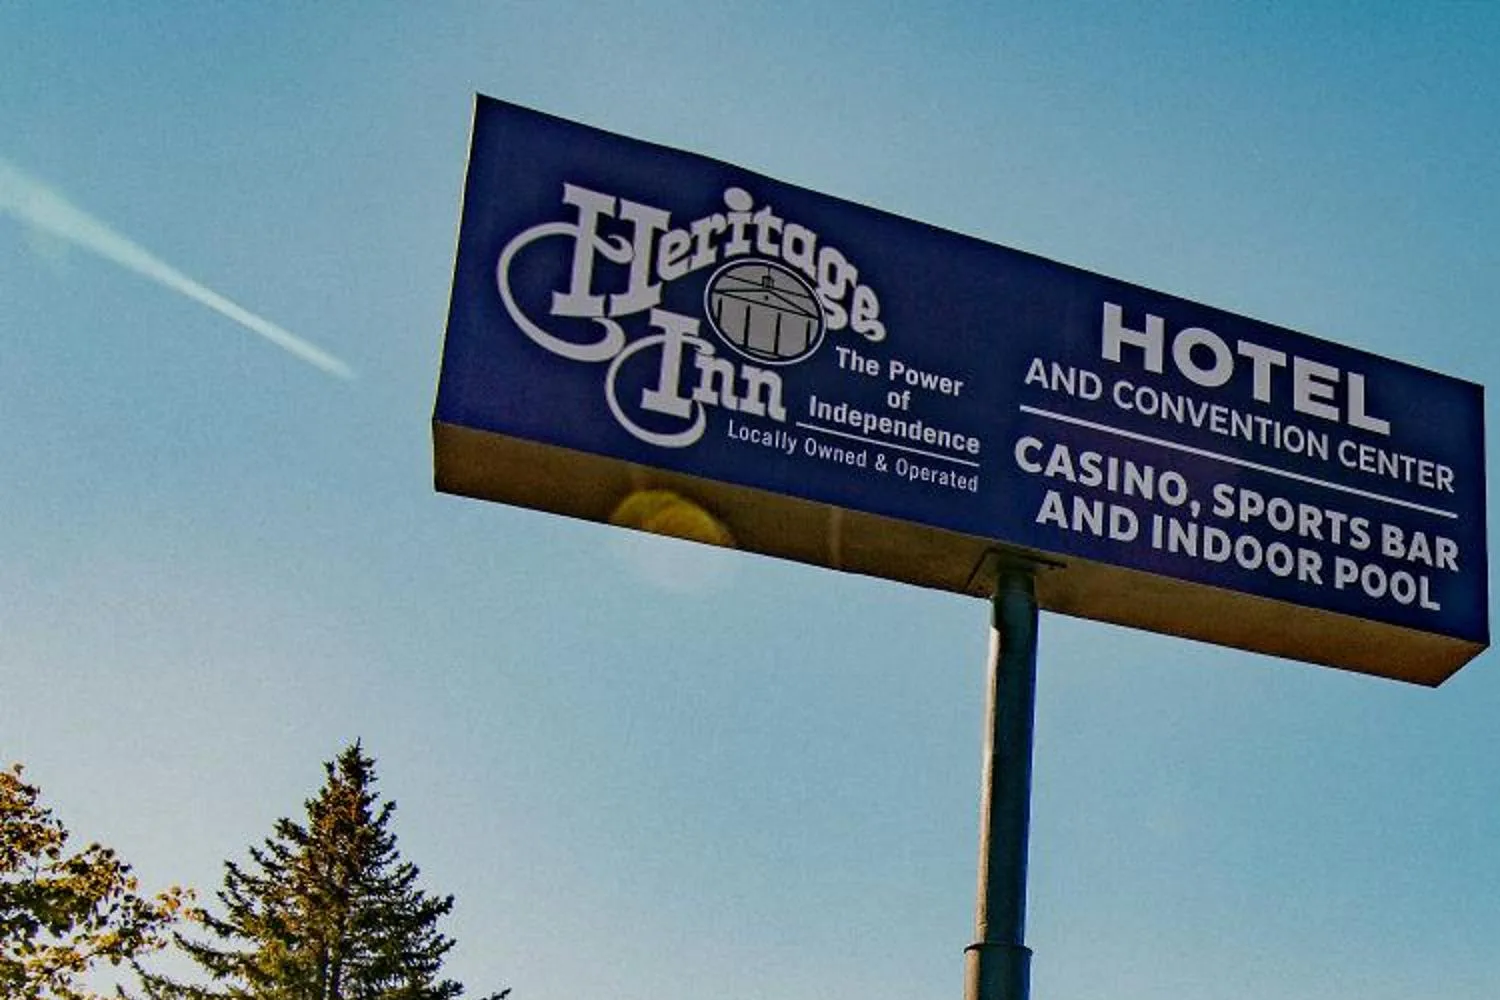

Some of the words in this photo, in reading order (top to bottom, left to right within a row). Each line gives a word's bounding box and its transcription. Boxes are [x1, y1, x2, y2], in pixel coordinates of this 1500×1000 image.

[497, 182, 886, 362] Heritage
[605, 309, 787, 448] Inn
[809, 395, 981, 454] Independence
[836, 346, 880, 376] The
[889, 360, 964, 396] Power
[887, 390, 911, 411] of
[1024, 357, 1102, 401] AND
[1113, 380, 1329, 460] CONVENTION
[1338, 439, 1455, 493] CENTER
[1101, 301, 1391, 436] HOTEL
[727, 418, 797, 455] Locally
[804, 437, 867, 467] Owned
[875, 453, 889, 473] &
[895, 457, 979, 493] Operated
[1014, 435, 1200, 517] CASINO,
[1213, 482, 1371, 551] SPORTS
[1382, 523, 1460, 572] BAR
[1035, 490, 1139, 541] AND
[1152, 516, 1323, 586] INDOOR
[1335, 557, 1441, 611] POOL
